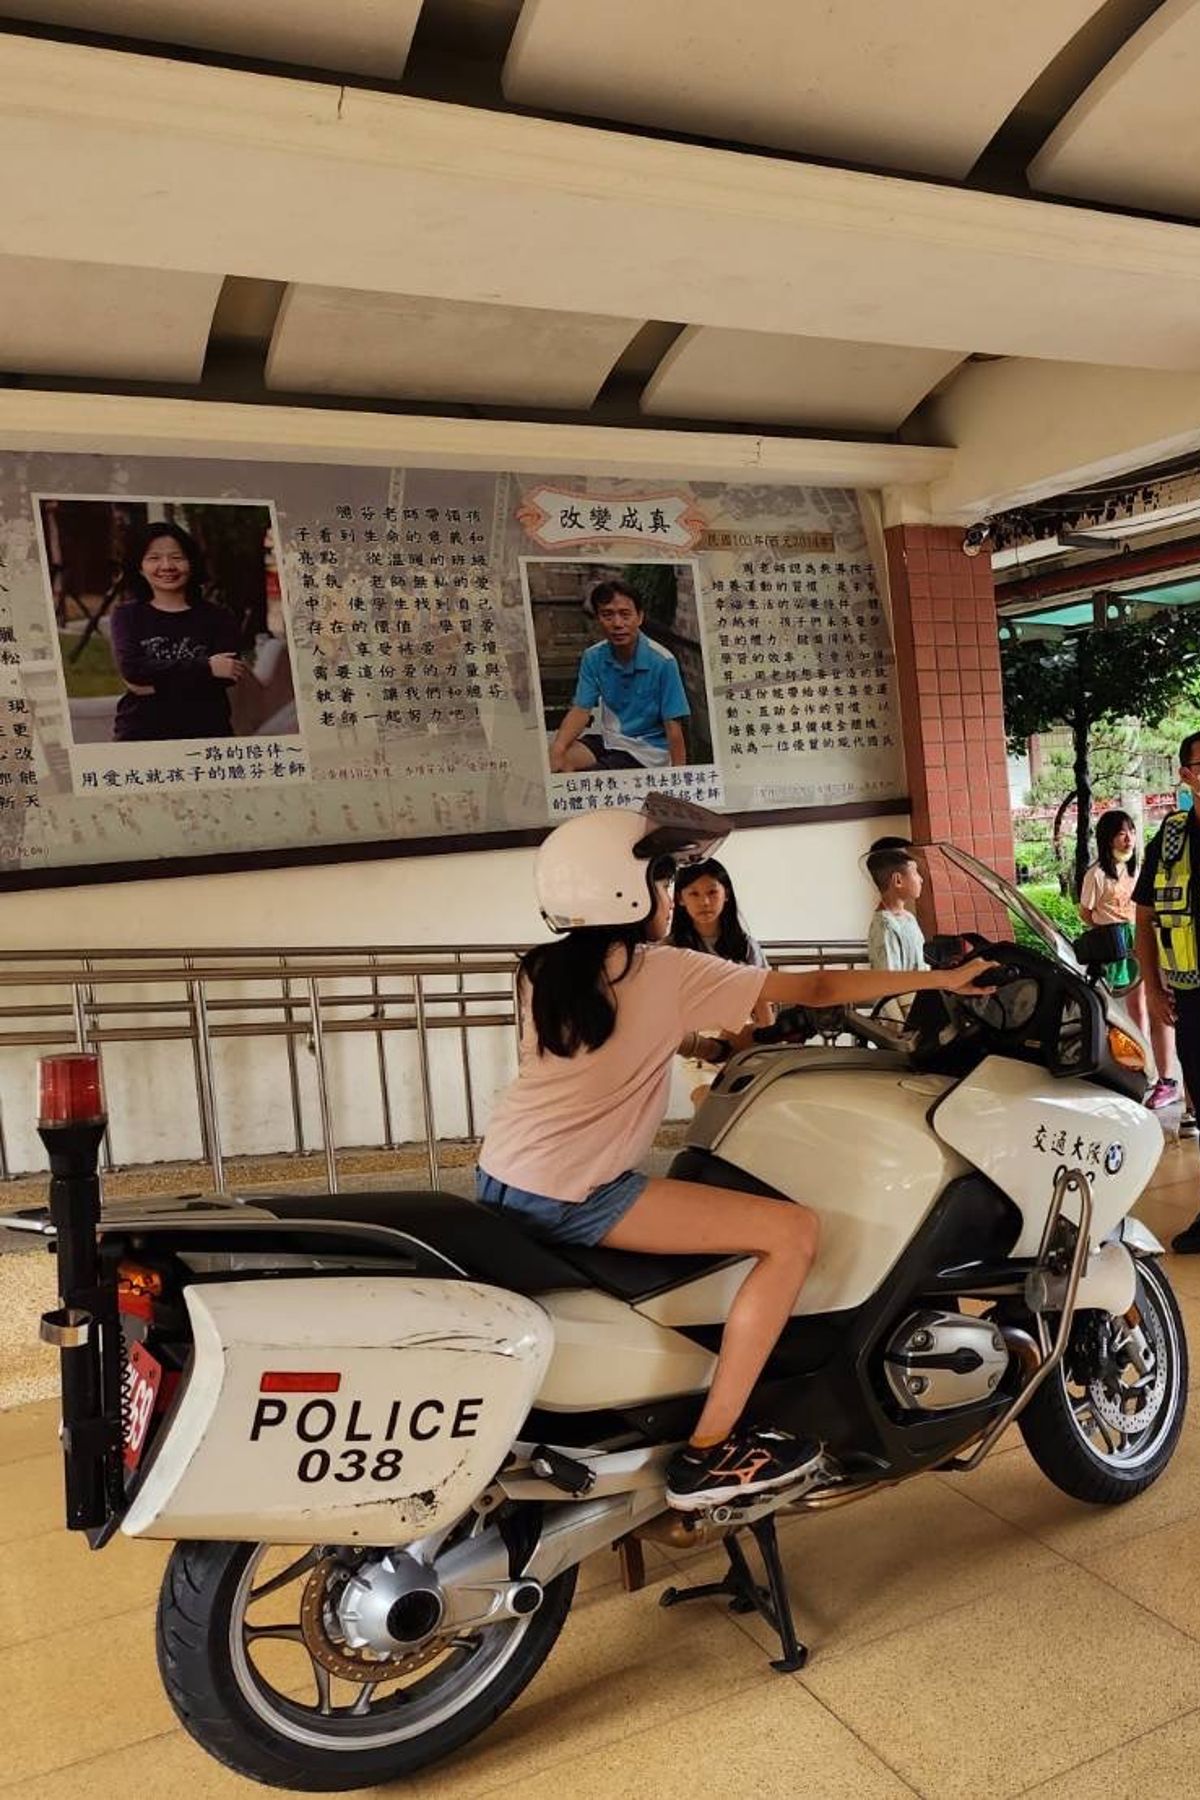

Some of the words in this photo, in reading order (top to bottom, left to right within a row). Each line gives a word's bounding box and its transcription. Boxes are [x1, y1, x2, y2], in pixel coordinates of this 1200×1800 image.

[560, 505, 671, 534] 改變成真
[250, 1398, 484, 1442] POLICE
[298, 1449, 403, 1483] 038
